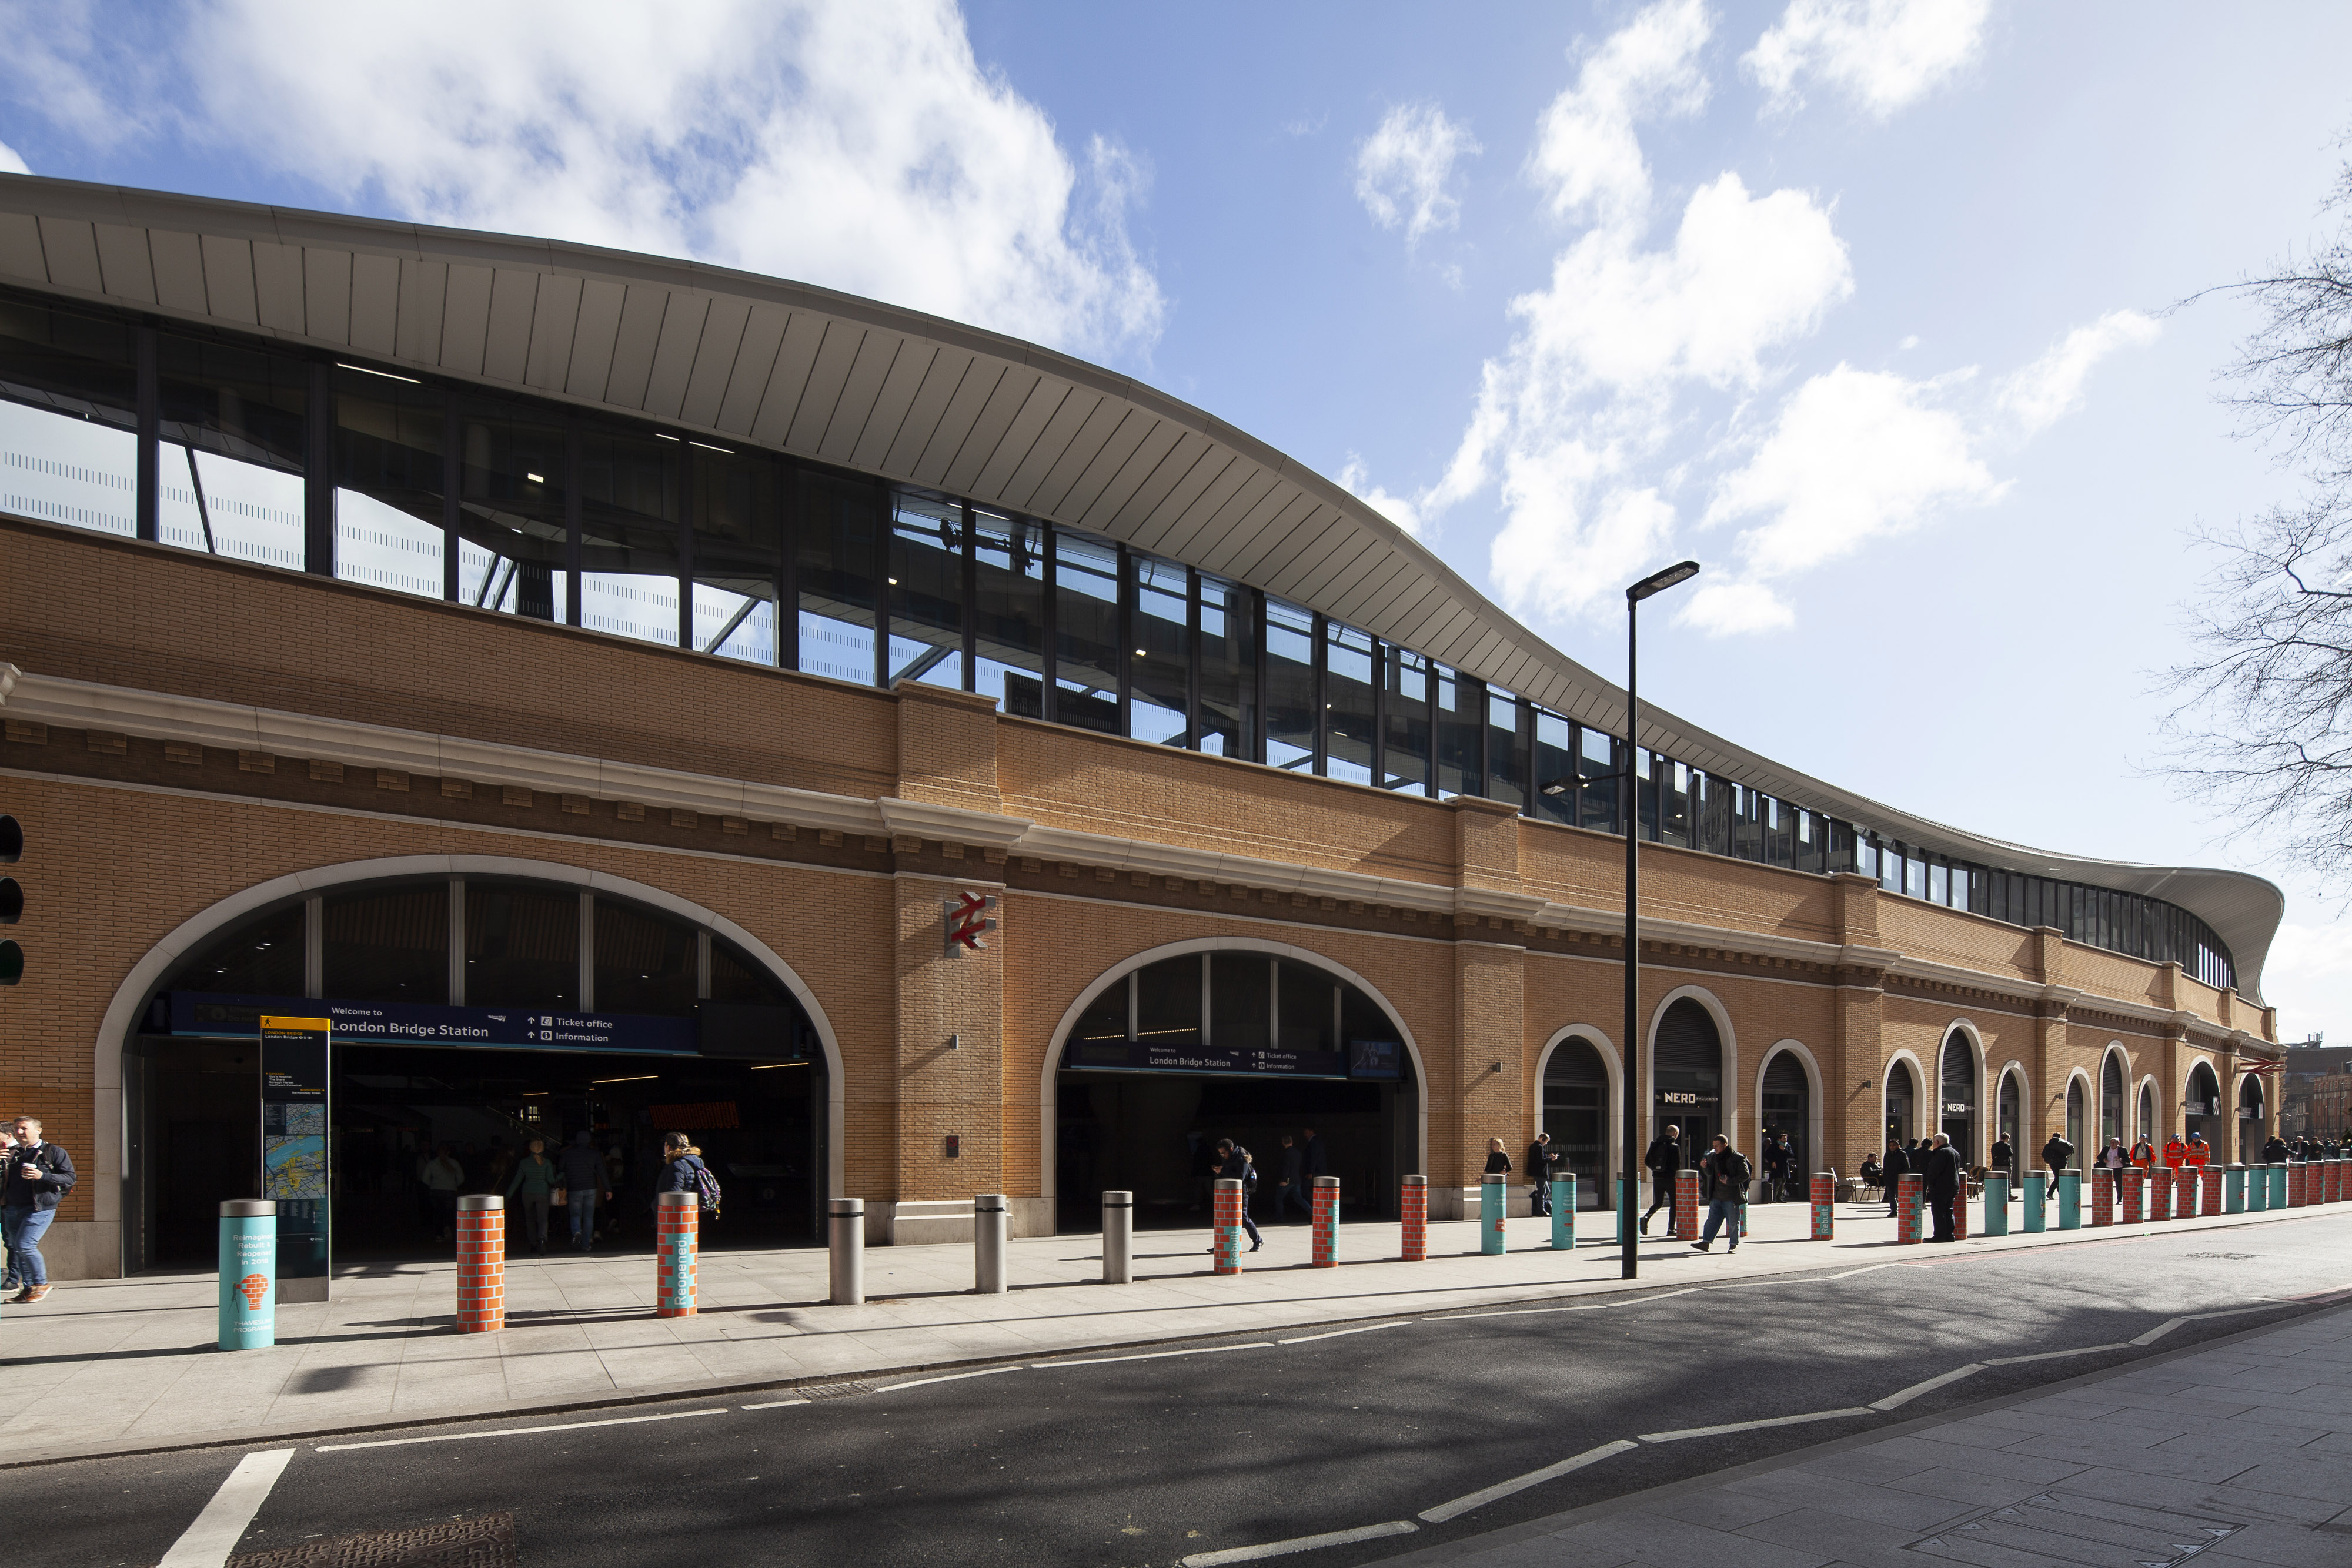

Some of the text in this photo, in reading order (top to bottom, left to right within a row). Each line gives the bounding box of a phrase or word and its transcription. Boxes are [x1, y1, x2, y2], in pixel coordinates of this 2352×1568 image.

[332, 1007, 370, 1015] Welcome
[556, 1018, 613, 1028] Ticket office
[331, 1021, 489, 1037] London Bridge Station
[556, 1032, 608, 1042] Information
[1150, 1056, 1230, 1067] London Bridge Station
[1665, 1092, 1696, 1104] NERO
[1947, 1103, 1965, 1112] NERO
[1230, 1228, 1238, 1265] Rebuilt.
[674, 1236, 689, 1305] Reopened.
